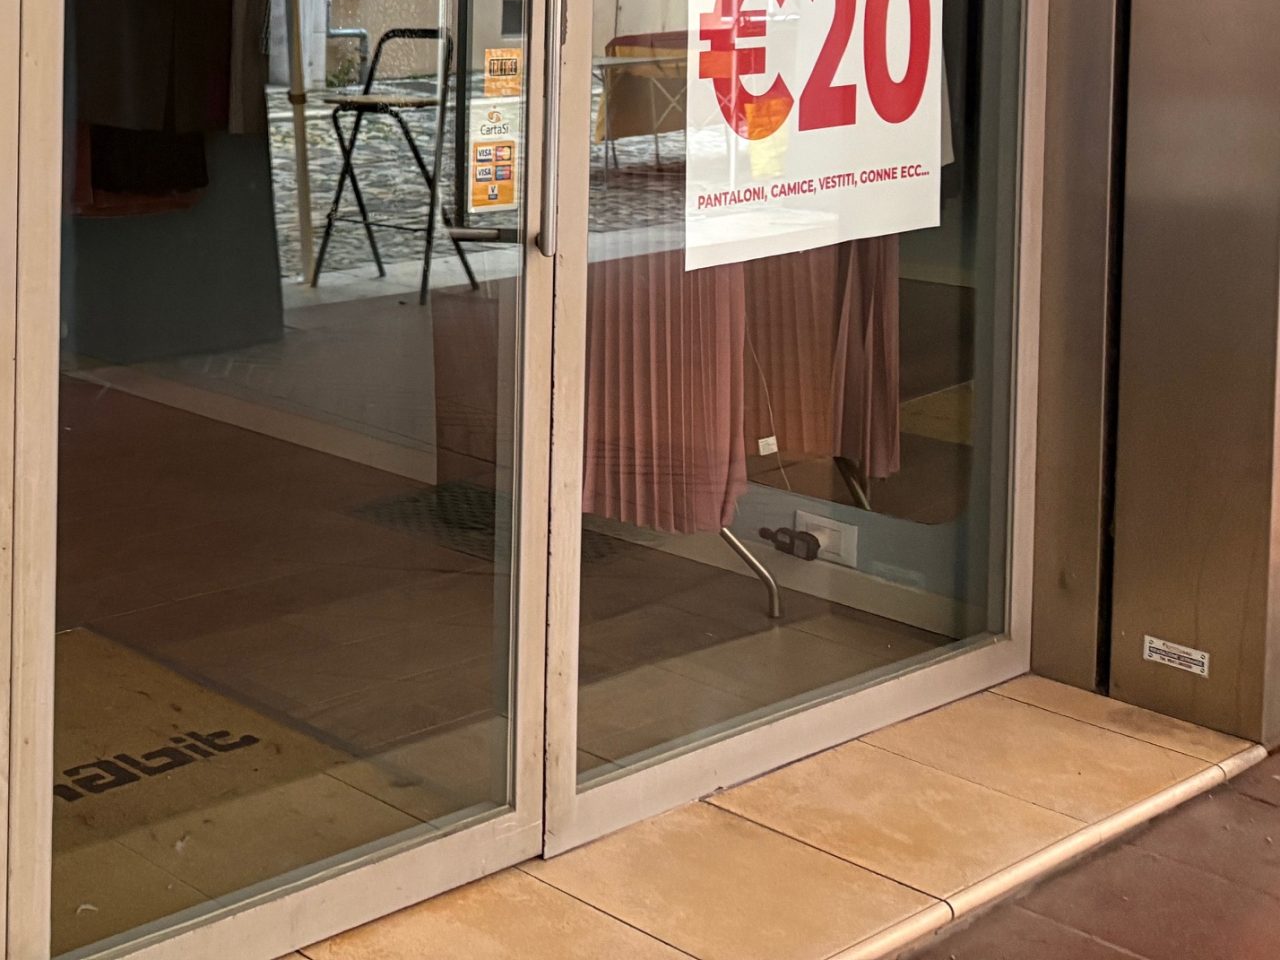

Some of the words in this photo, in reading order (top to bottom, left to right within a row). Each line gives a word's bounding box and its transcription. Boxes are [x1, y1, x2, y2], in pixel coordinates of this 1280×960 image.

[697, 186, 768, 210] PANTALONI,
[770, 179, 817, 199] CAMICE,
[819, 172, 858, 191] VESTITI,
[859, 167, 898, 184] GONNE
[900, 163, 930, 179] ECC...
